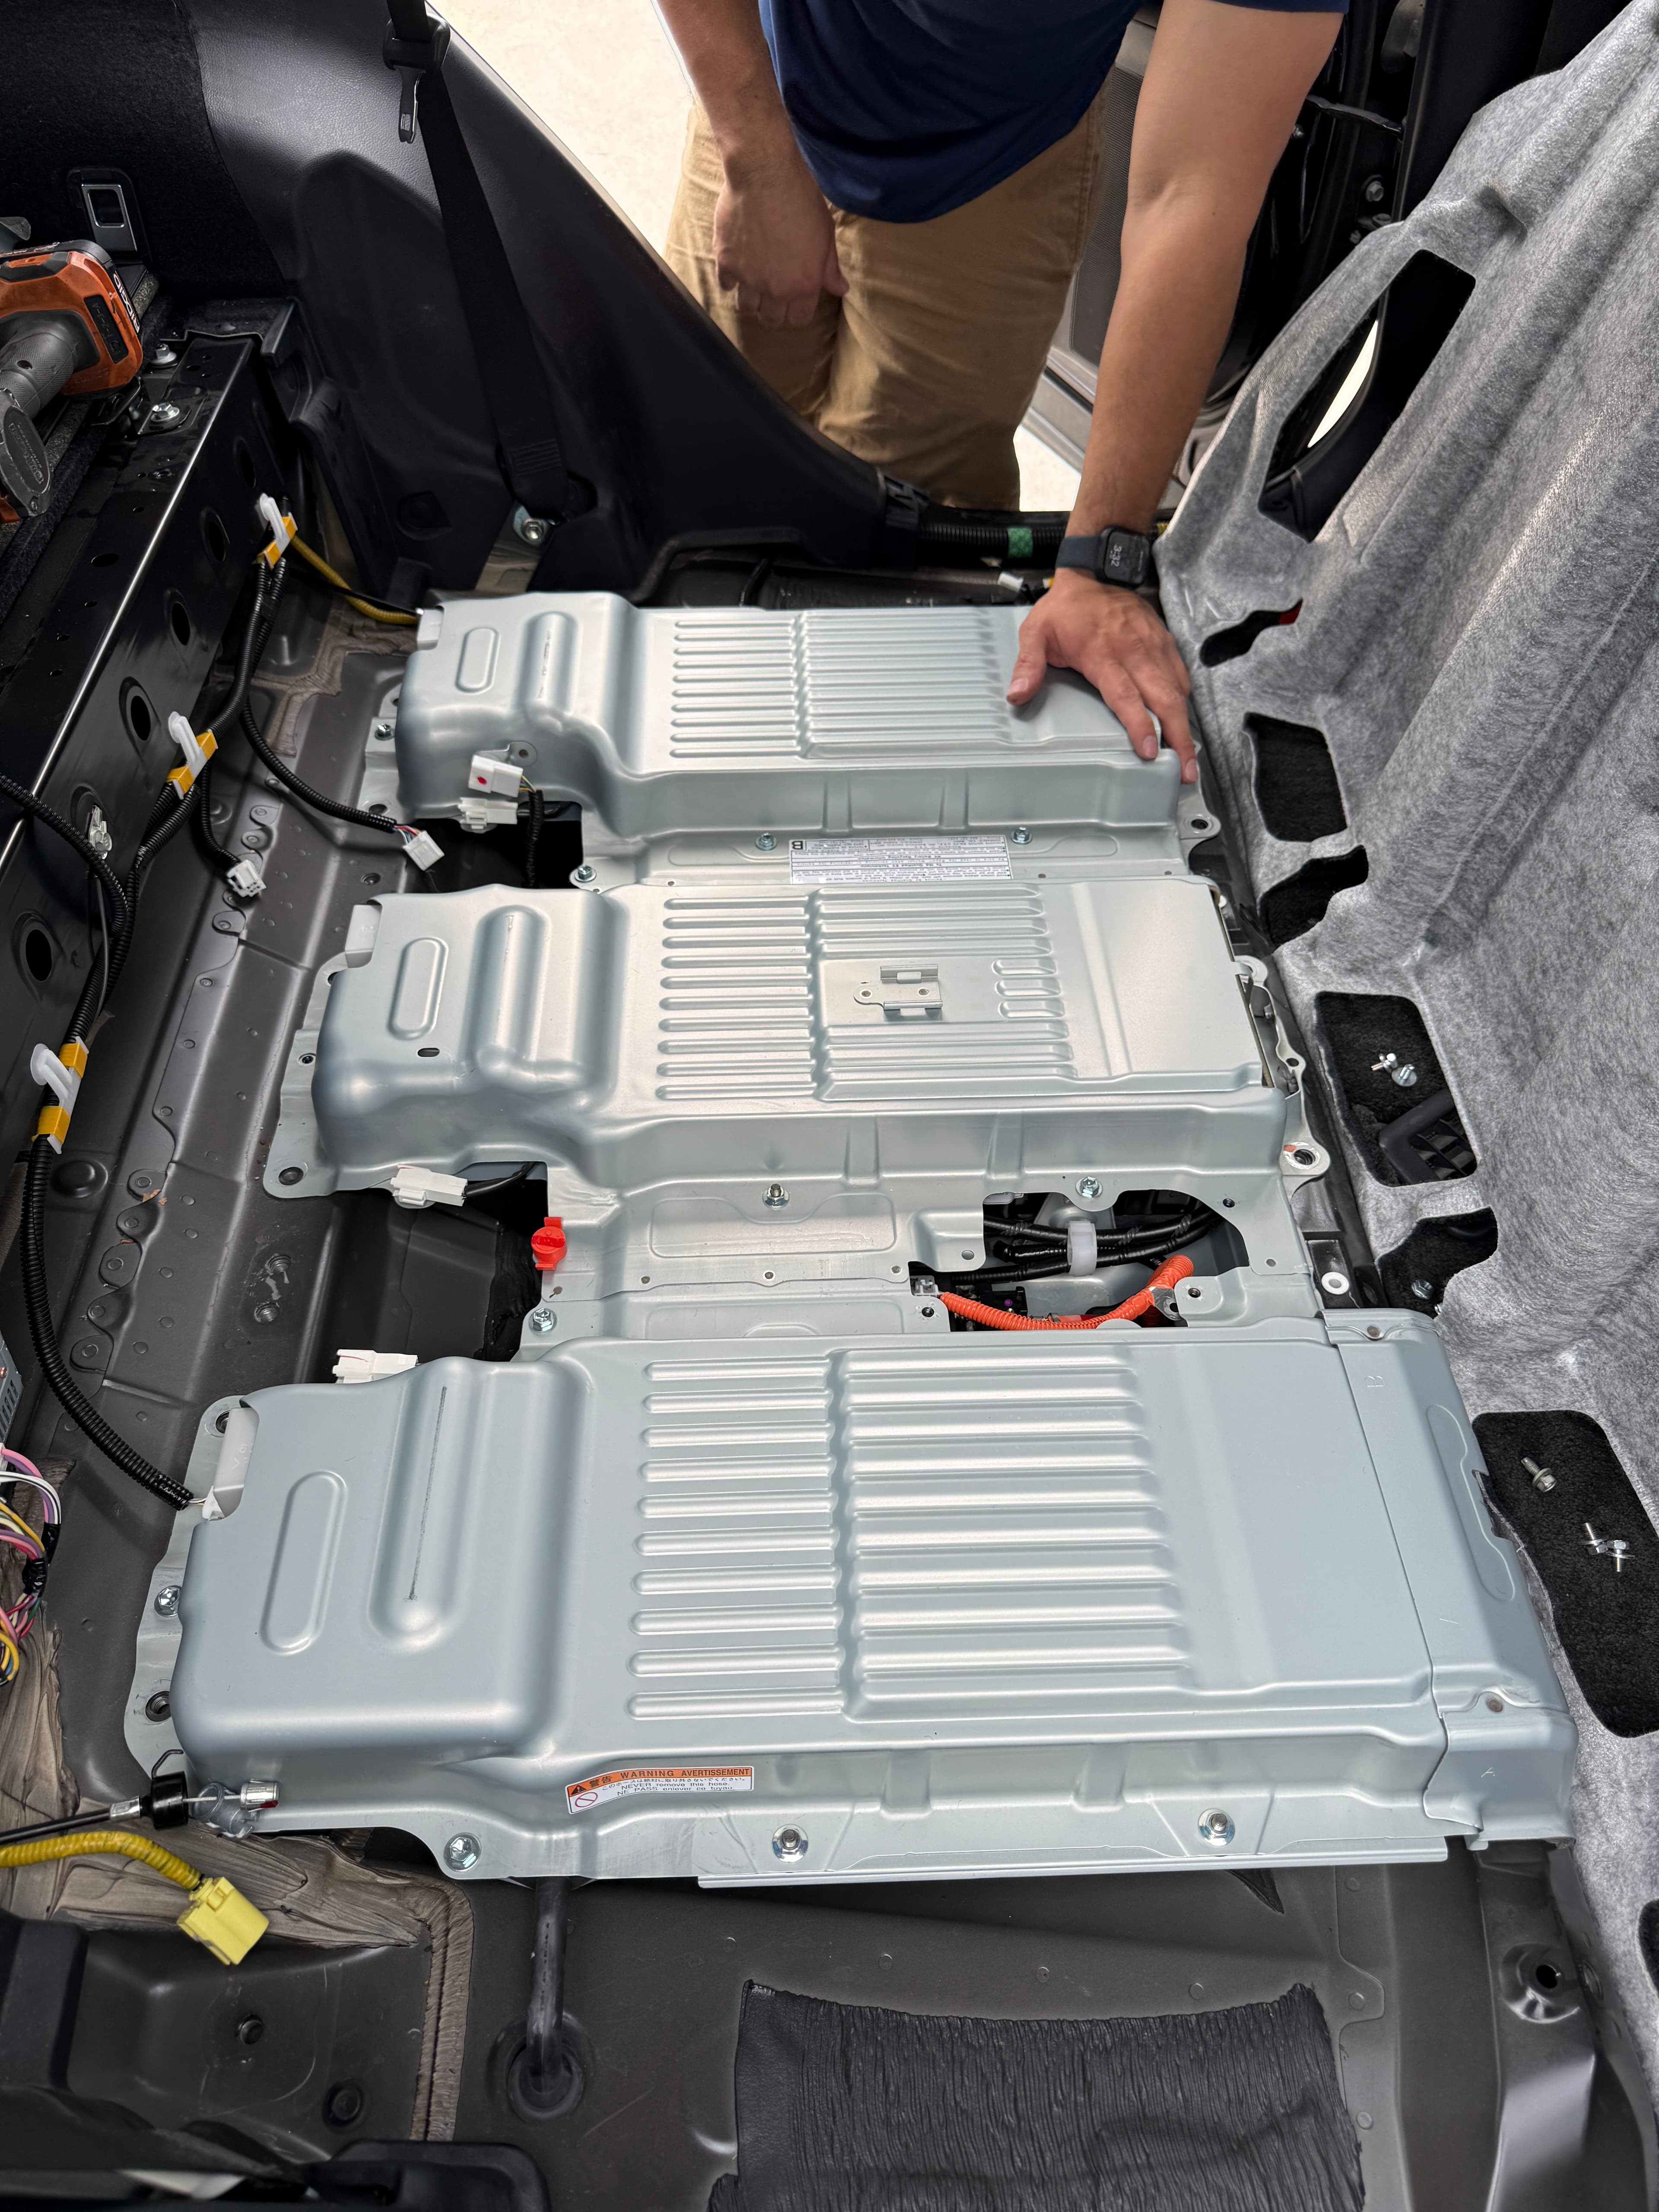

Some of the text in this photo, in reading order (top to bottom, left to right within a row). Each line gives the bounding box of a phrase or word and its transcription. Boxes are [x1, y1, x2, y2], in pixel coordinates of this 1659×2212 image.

[113, 273, 140, 334] RIDGID
[1111, 544, 1122, 567] 3:32
[791, 841, 803, 849] B
[1365, 1376, 1385, 1388] B
[620, 1770, 674, 1779] WARNING
[589, 1775, 612, 1788] 警告
